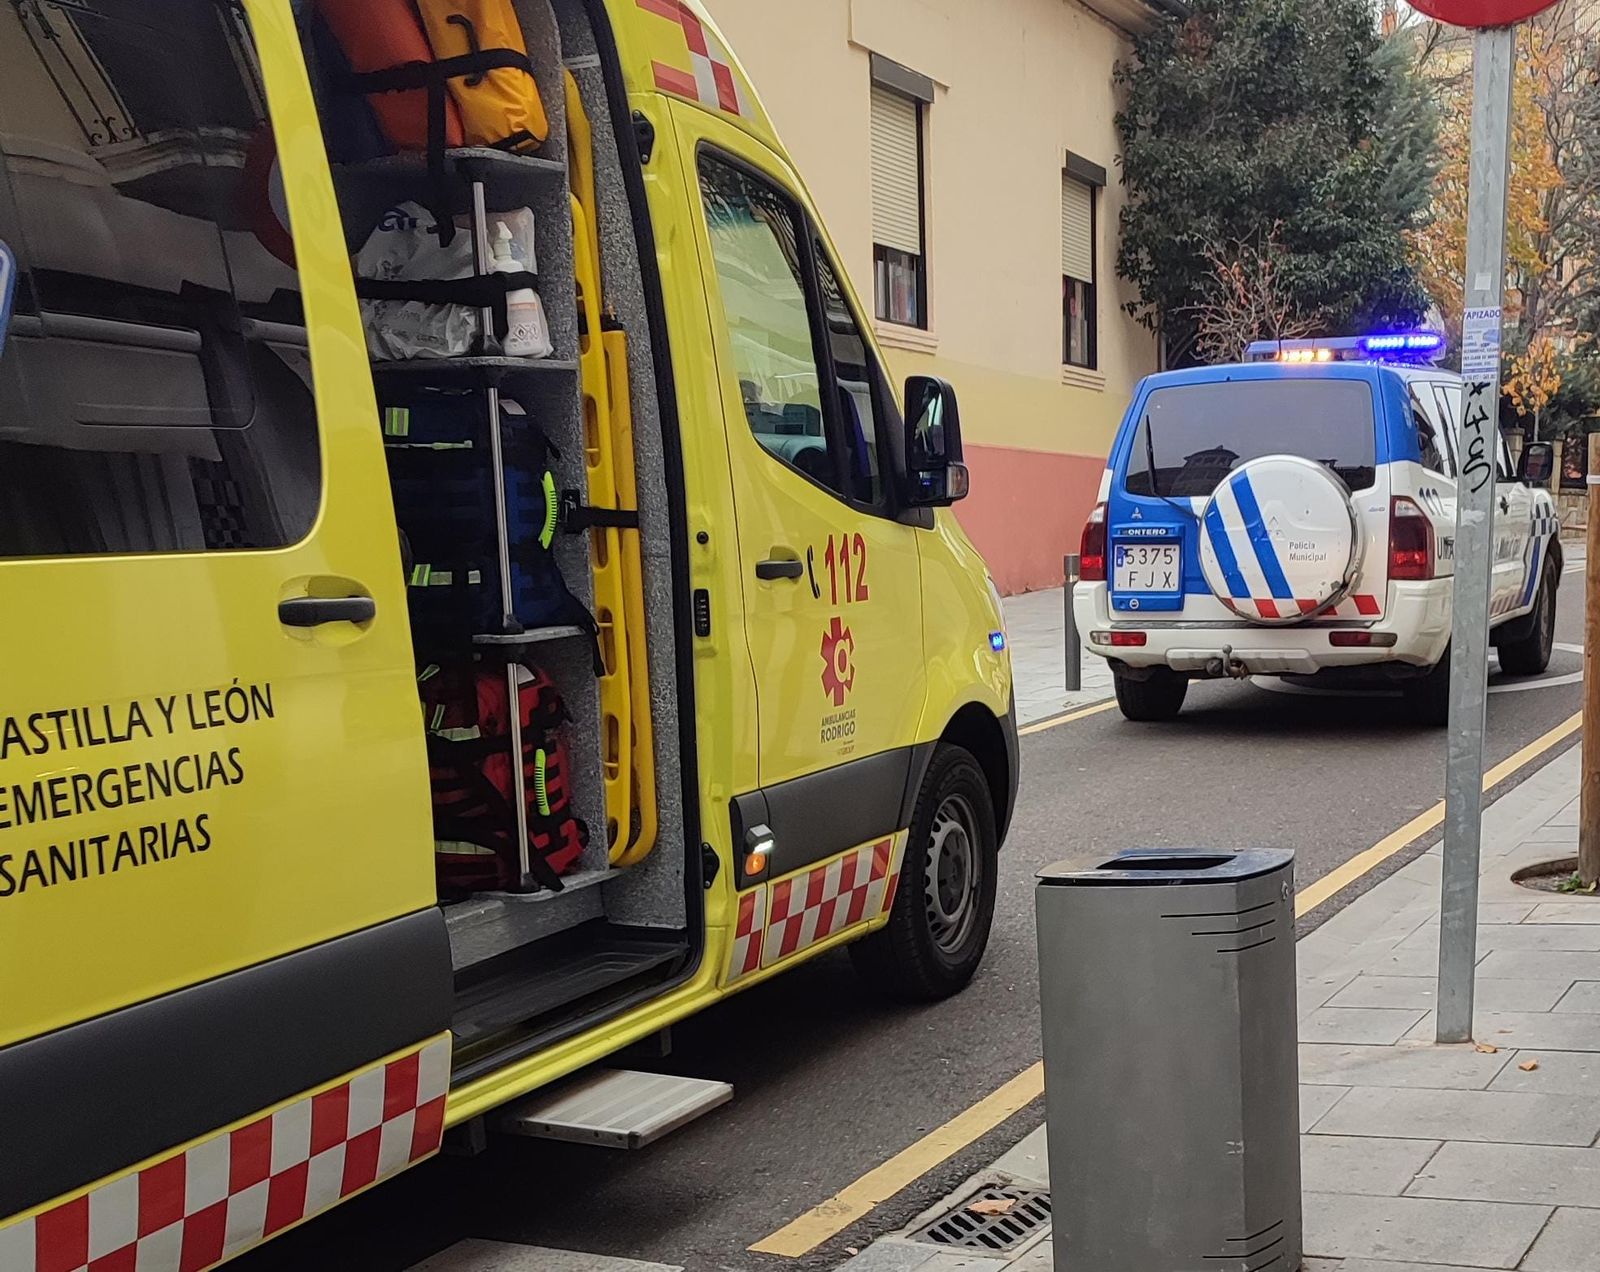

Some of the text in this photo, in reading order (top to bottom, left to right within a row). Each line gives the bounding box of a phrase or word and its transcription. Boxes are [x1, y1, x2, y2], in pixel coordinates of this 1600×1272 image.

[1126, 548, 1173, 565] 5375
[1288, 552, 1327, 562] Municipal
[824, 533, 868, 605] 112
[154, 695, 177, 734] Y
[186, 677, 275, 730] LEÓN
[821, 709, 856, 727] AMBULANCIAS
[820, 721, 856, 744] RODRIGO
[0, 813, 211, 897] SANITARIAS
